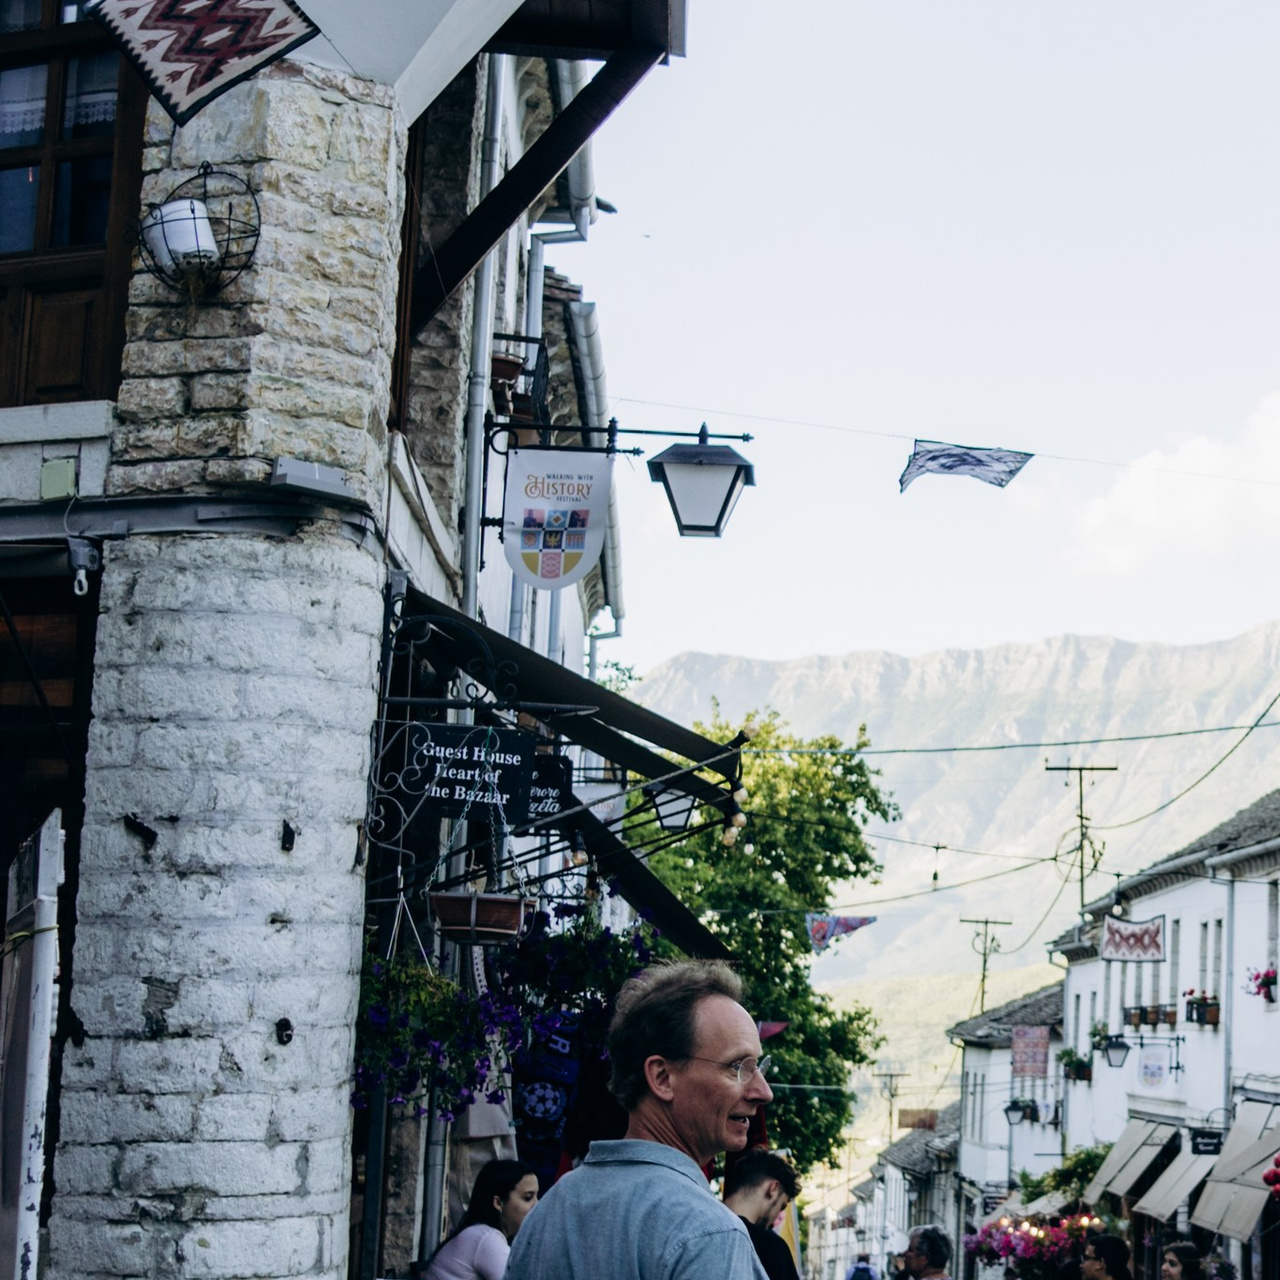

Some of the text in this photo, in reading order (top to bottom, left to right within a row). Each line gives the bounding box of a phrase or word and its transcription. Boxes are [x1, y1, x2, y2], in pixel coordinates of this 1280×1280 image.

[524, 474, 593, 499] HISTORY
[422, 741, 521, 766] Guest House
[435, 763, 502, 783] Heart of
[424, 782, 510, 804] the Bazaar
